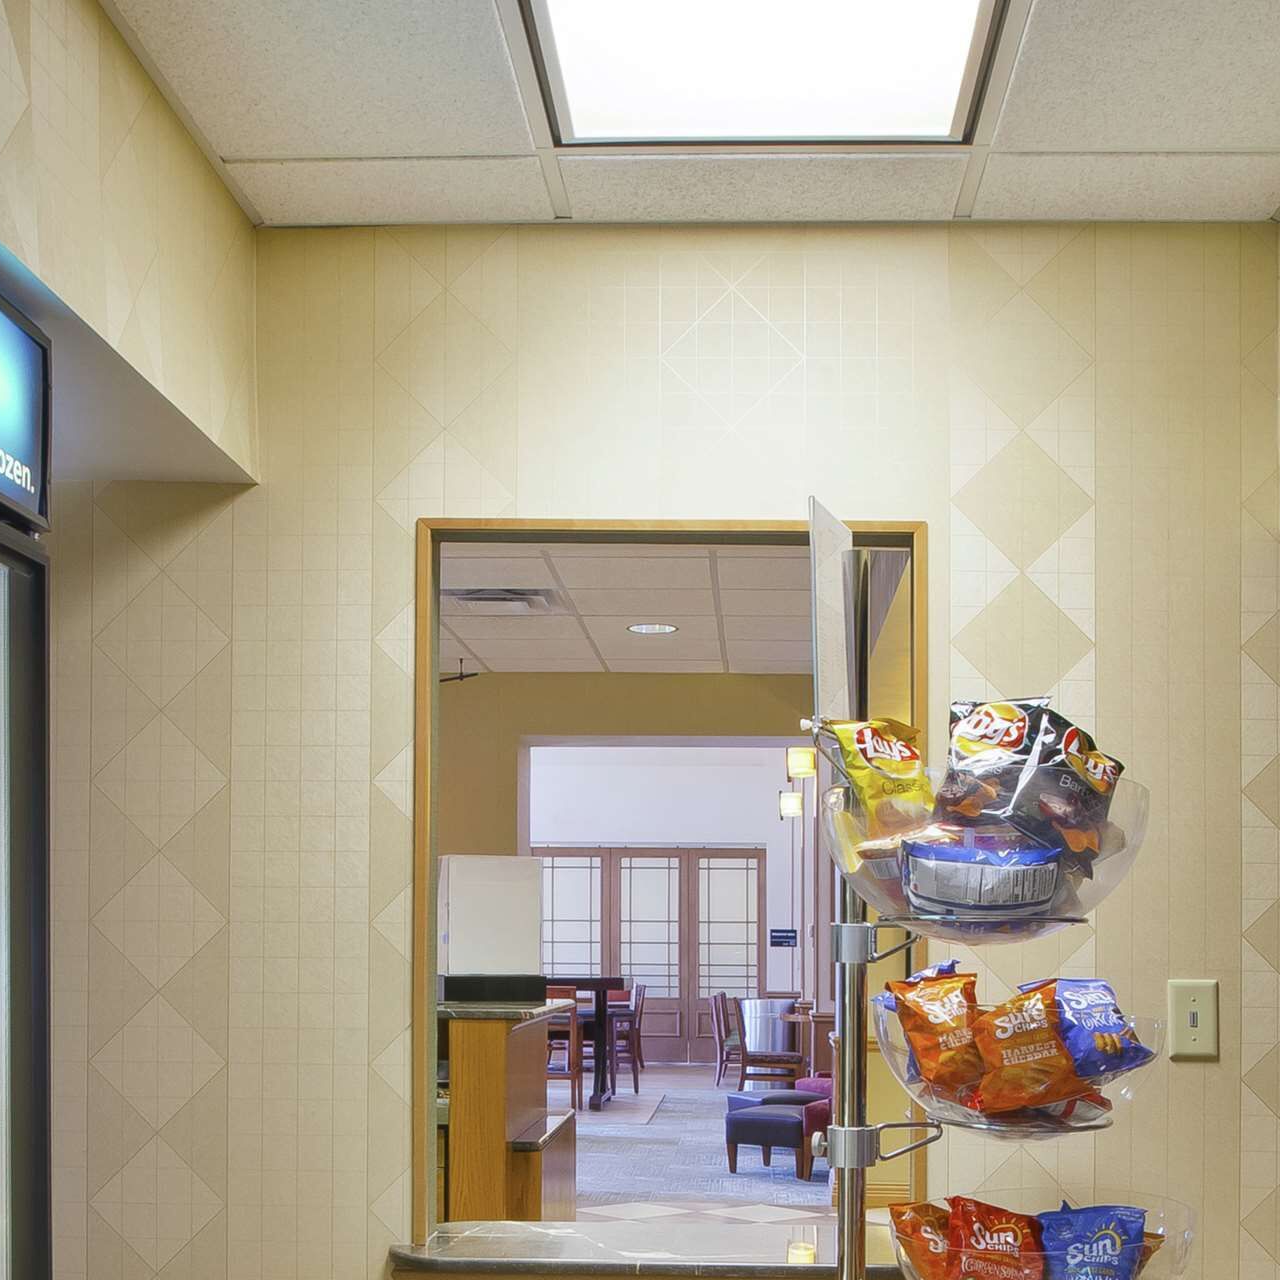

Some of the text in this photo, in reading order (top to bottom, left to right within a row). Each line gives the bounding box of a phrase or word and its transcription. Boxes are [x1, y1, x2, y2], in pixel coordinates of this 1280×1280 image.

[863, 727, 908, 761] Lay's
[1001, 1041, 1057, 1059] HARVEST
[1003, 1049, 1059, 1066] CHEDDAR
[971, 1221, 1016, 1250] Sun
[987, 1243, 1019, 1258] CHIPS
[1083, 1254, 1119, 1265] CHIPS
